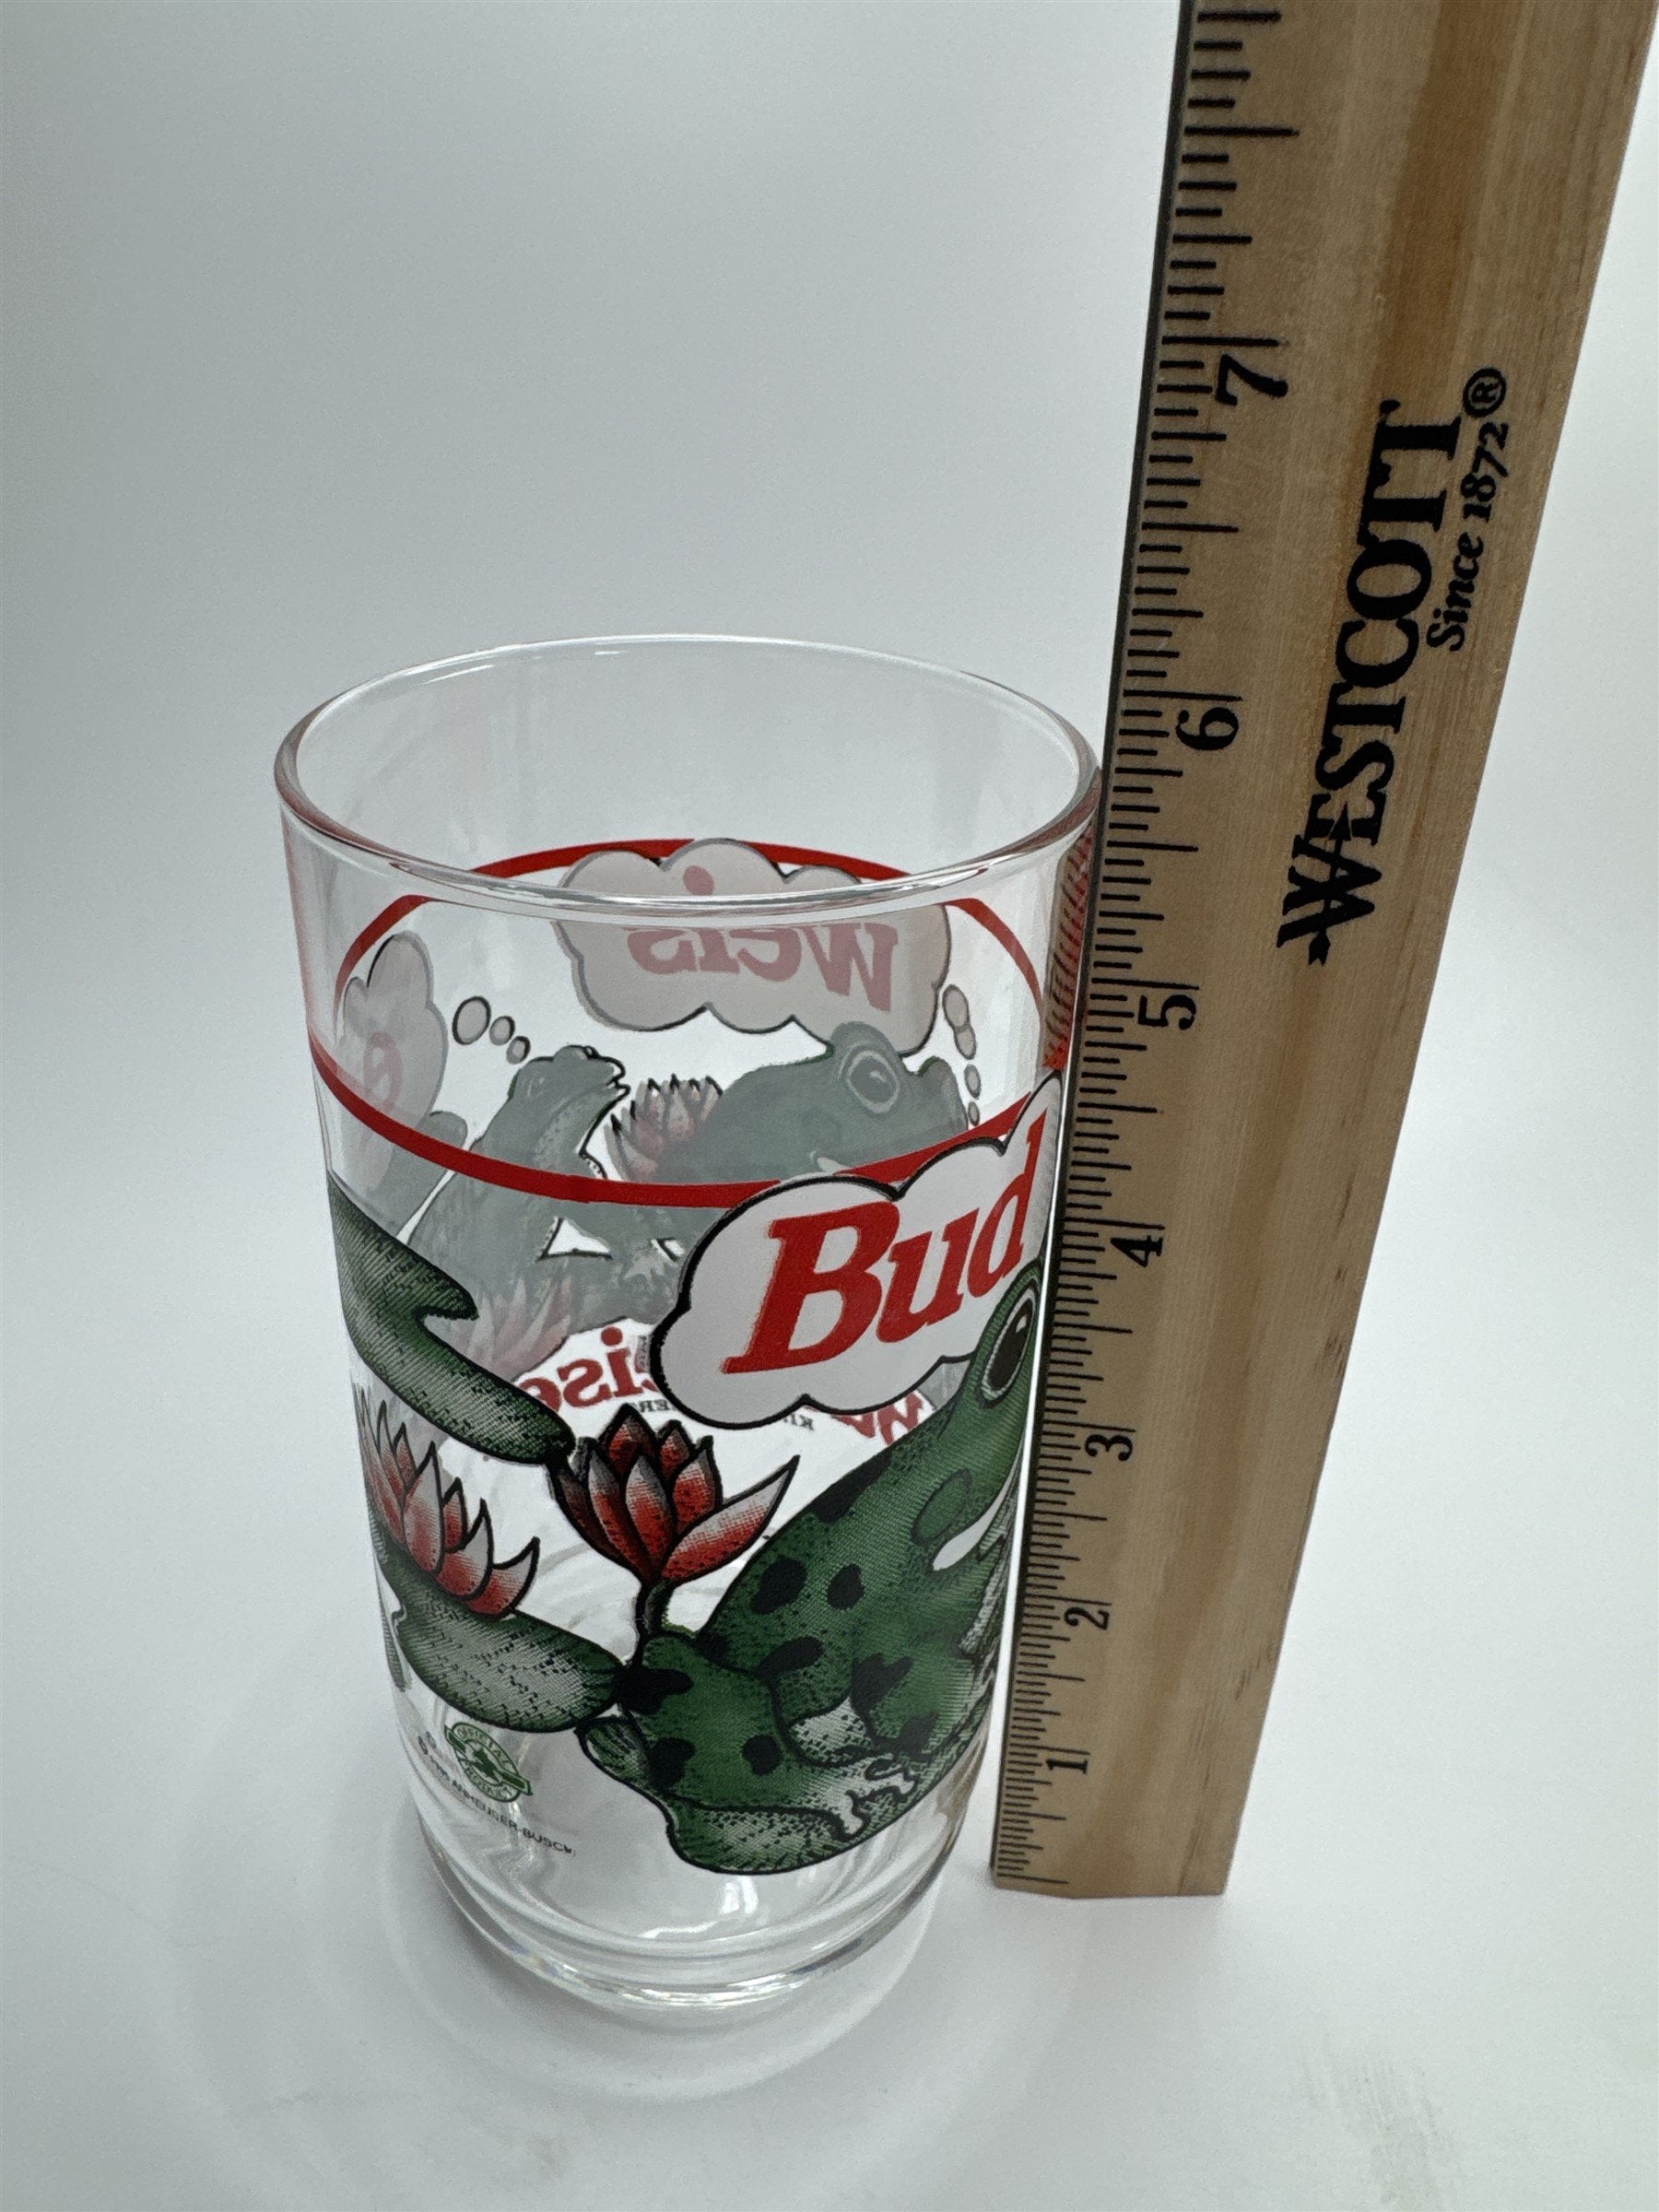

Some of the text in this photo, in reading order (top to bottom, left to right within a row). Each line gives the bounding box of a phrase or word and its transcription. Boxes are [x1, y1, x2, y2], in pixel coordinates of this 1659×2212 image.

[1214, 353, 1288, 407] 7
[1426, 532, 1485, 653] Since
[1277, 398, 1463, 948] WESTCOTT
[1175, 707, 1240, 752] 6
[1137, 994, 1197, 1030] 5
[722, 1108, 1047, 1373] Bud
[1110, 1234, 1164, 1269] 4
[1084, 1433, 1134, 1462] 3
[1064, 1606, 1110, 1630] 2
[1046, 1759, 1088, 1774] 1
